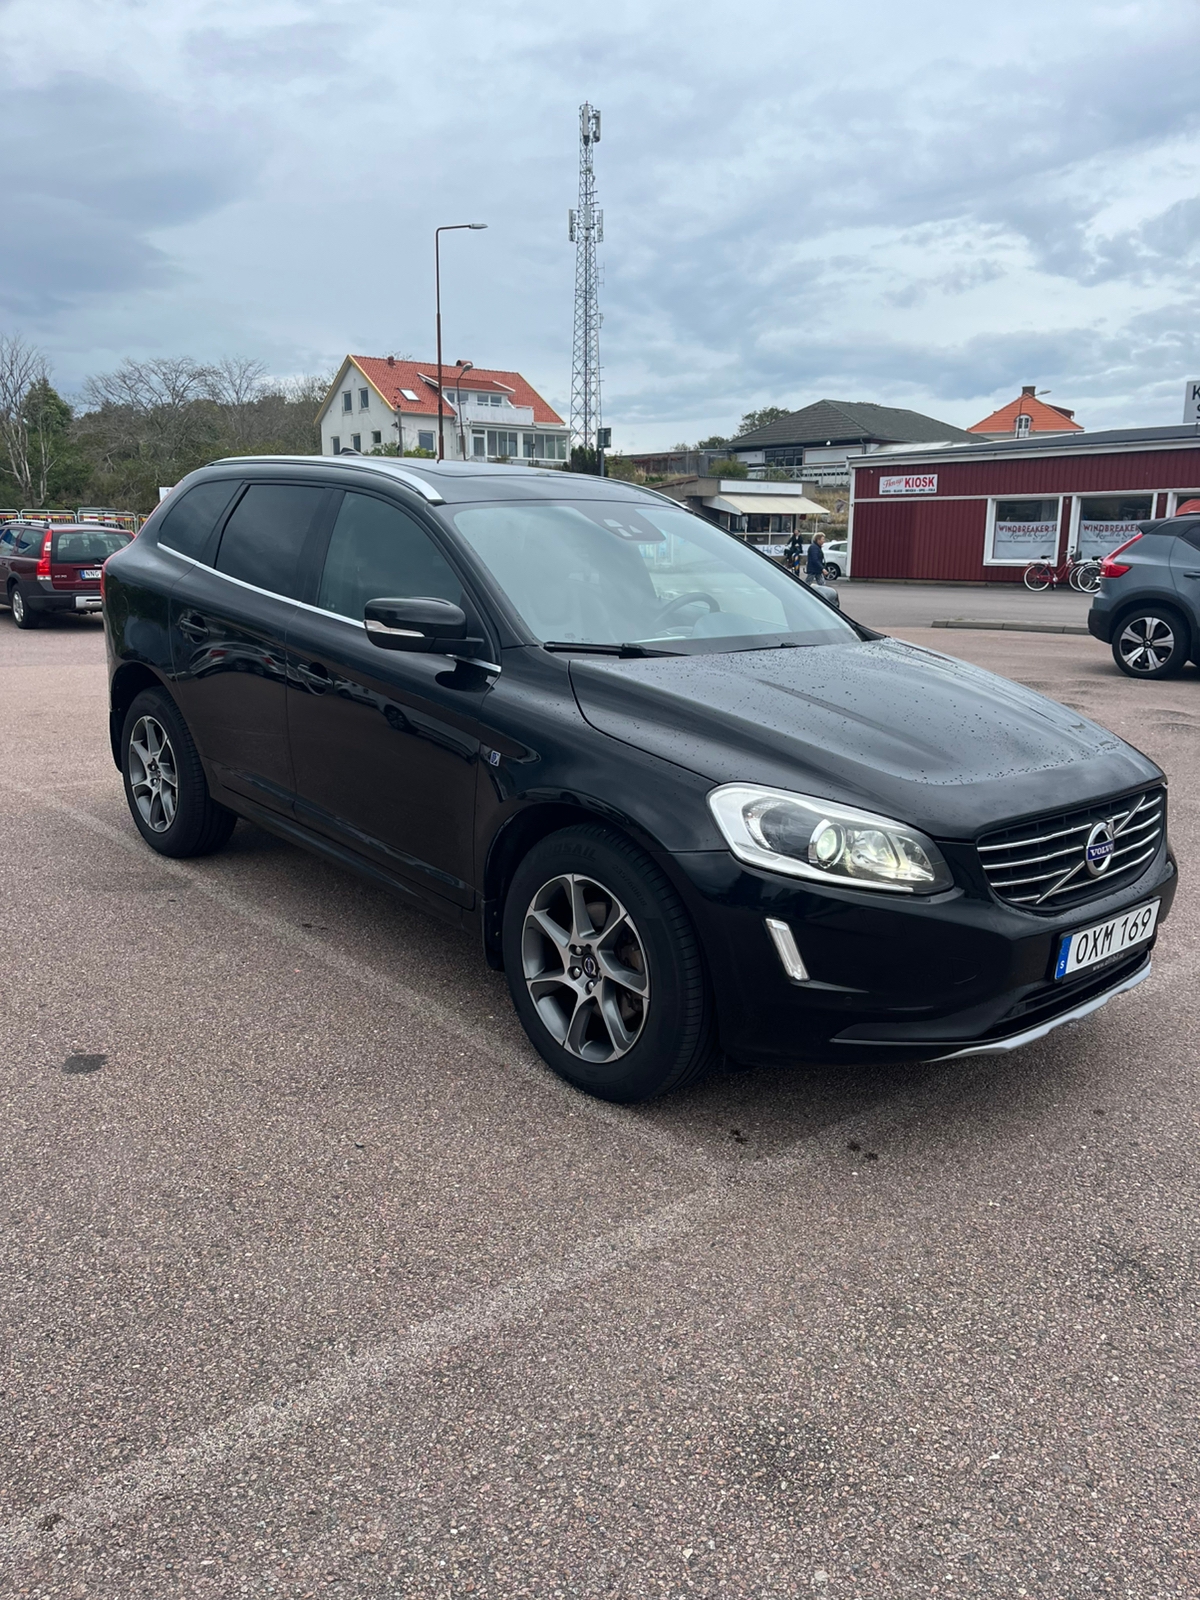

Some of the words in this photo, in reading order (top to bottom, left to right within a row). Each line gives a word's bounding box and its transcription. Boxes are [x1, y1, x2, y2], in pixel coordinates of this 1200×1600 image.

[904, 476, 935, 488] KIOSK
[1076, 923, 1115, 964] OXM
[1121, 907, 1152, 946] 169
[1060, 960, 1065, 970] S
